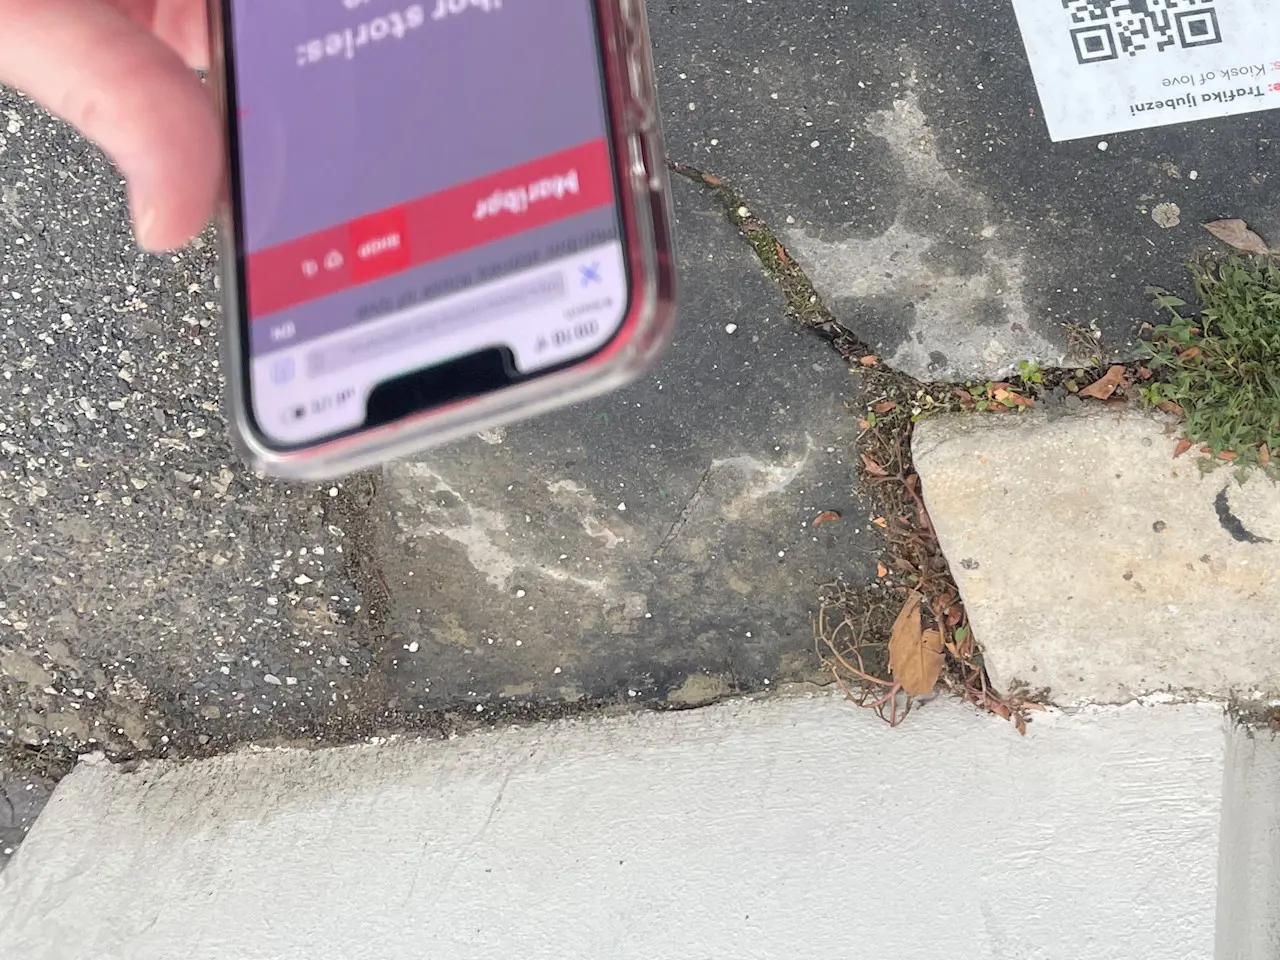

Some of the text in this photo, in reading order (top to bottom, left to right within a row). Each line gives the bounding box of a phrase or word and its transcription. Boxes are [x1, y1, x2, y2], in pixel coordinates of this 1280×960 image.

[295, 4, 425, 67] stories:
[1200, 69, 1217, 85] of
[1221, 63, 1266, 79] Kiosk
[1161, 75, 1195, 88] love
[1202, 85, 1265, 103] Trafika
[1129, 95, 1197, 117] ljubezni
